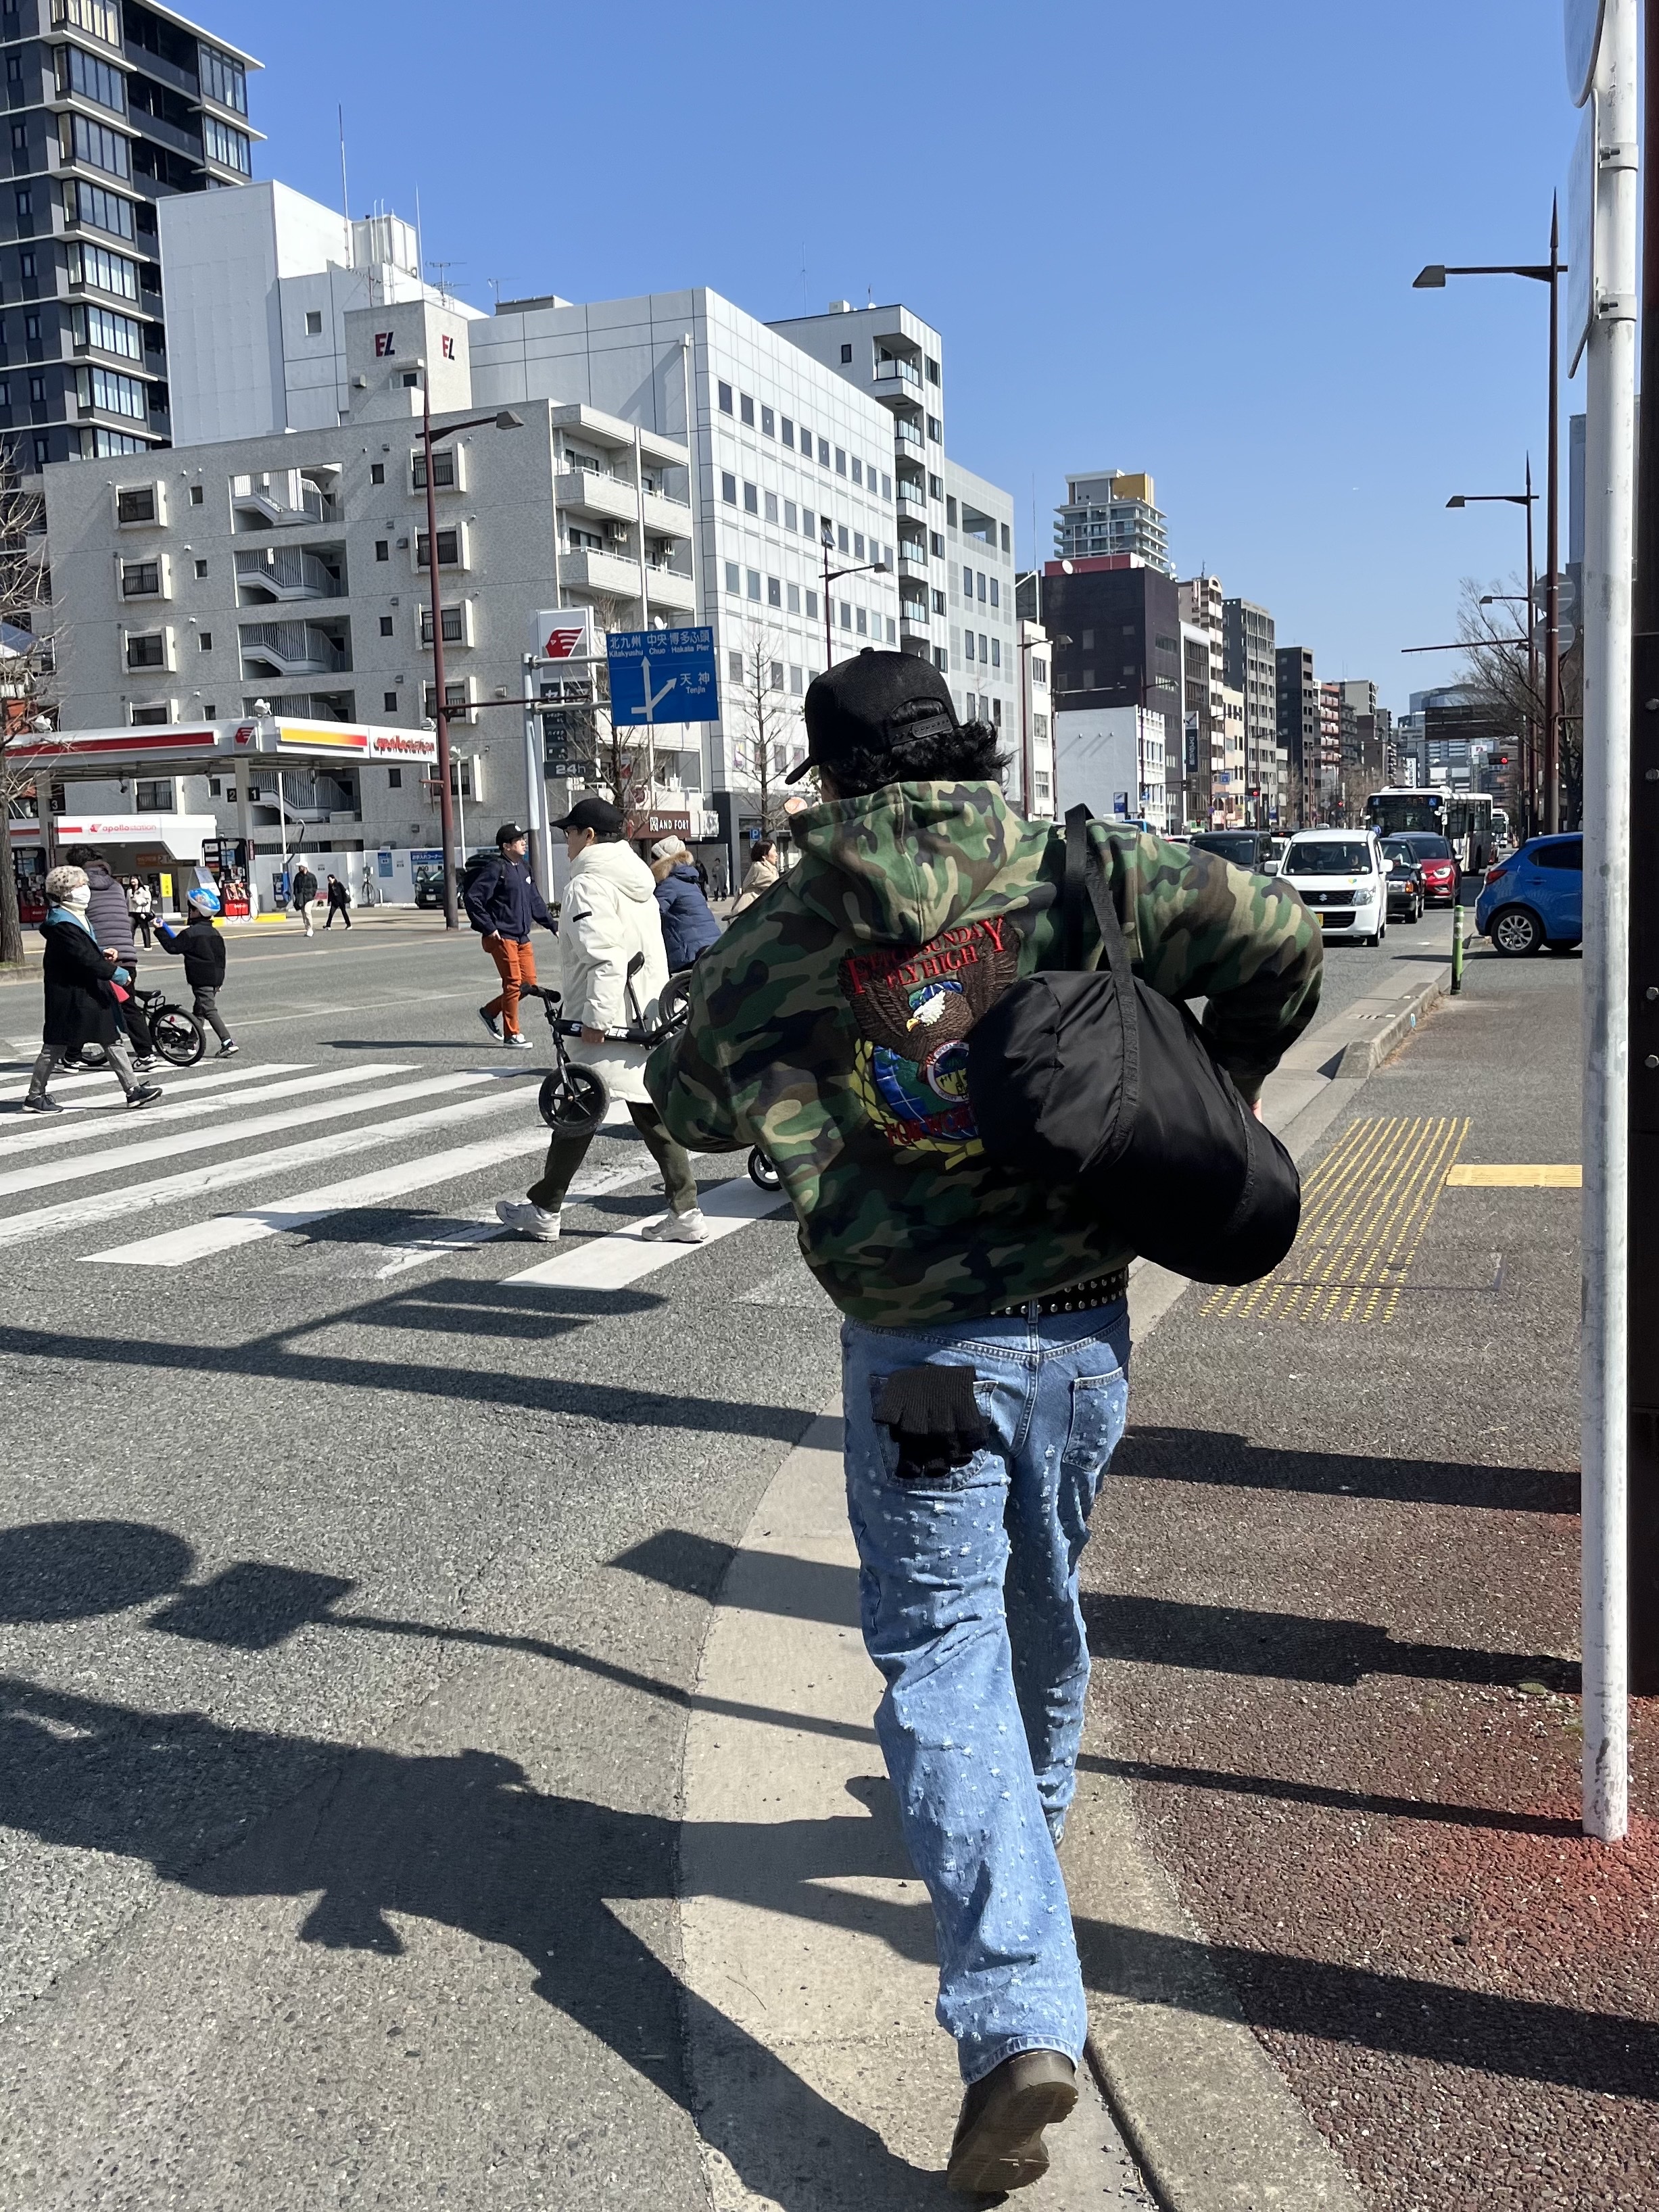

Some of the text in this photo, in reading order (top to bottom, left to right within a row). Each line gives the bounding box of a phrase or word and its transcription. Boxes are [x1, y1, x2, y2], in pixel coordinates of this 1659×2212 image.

[375, 331, 395, 358] EL
[441, 334, 455, 360] EL
[610, 635, 642, 649] 北九州
[609, 649, 644, 658] Kitakyushu
[696, 644, 710, 652] Pier
[680, 671, 710, 686] 天神
[686, 686, 706, 695] Tenjin
[556, 764, 586, 775] 24h
[230, 790, 236, 800] 2
[251, 790, 257, 800] 1
[51, 800, 58, 810] 3
[102, 824, 157, 833] apollostation
[752, 829, 759, 839] P
[886, 944, 979, 988] FLY HIGH
